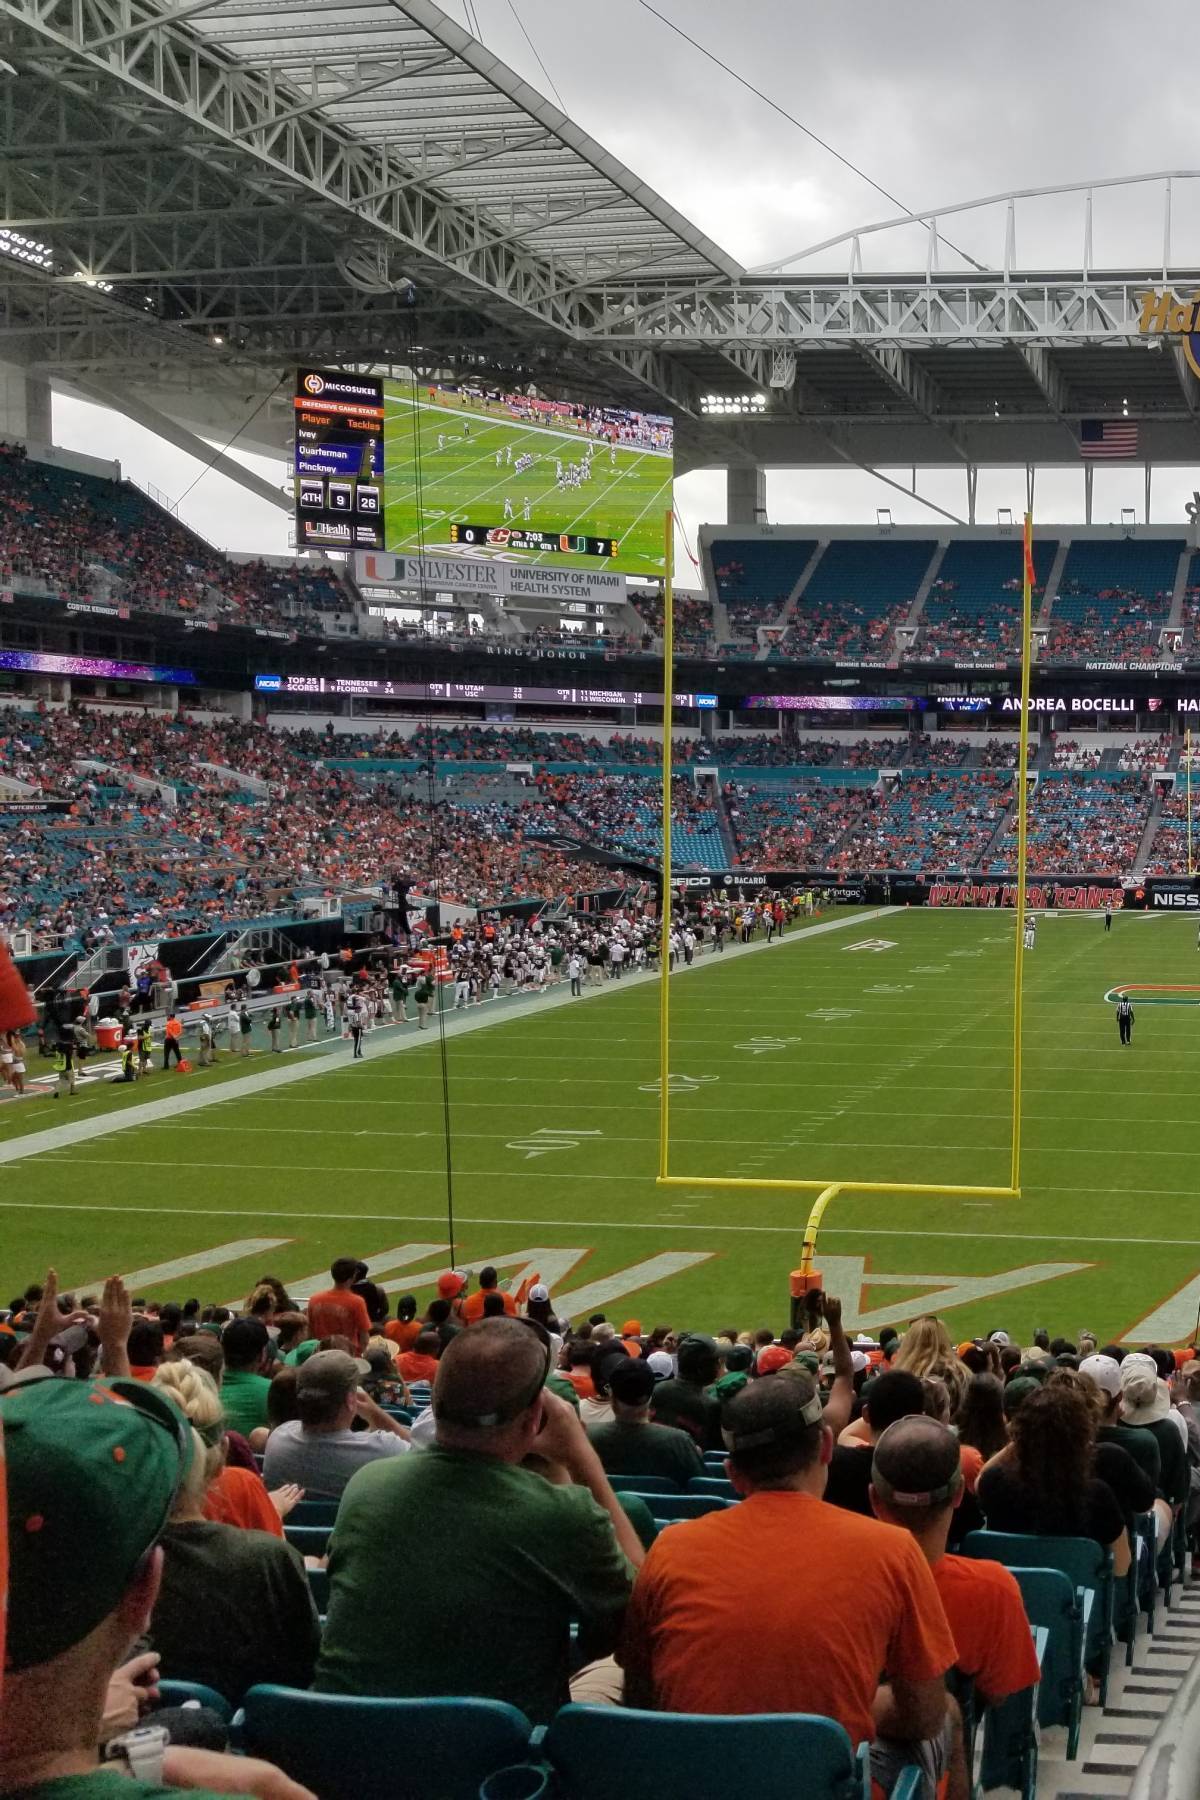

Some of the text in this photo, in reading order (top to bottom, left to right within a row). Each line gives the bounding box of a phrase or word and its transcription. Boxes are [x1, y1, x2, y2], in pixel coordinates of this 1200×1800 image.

[325, 383, 376, 395] MICCOSUKEE
[302, 414, 380, 430] Player Tackles
[299, 429, 316, 439] Ivey
[299, 446, 347, 458] Quarterman
[299, 462, 336, 473] Pinckney
[302, 493, 321, 502] 4TH
[337, 496, 344, 505] 9
[361, 498, 376, 508] 26
[466, 530, 474, 541] 0
[525, 532, 543, 542] 7:03
[597, 543, 604, 554] 7
[408, 559, 496, 583] SYLVESTER
[510, 568, 620, 587] UNIVERSITY OF MIAMI
[510, 582, 591, 597] HEALTH SYSTEM
[67, 603, 91, 613] CORTEZ
[487, 646, 587, 660] RING HONOR
[1086, 662, 1182, 671] NATIONAL CHAMPIONS
[1002, 698, 1066, 710] ANDREA
[1072, 698, 1134, 711] BOCELLI
[734, 876, 766, 885] BACARDÍ
[928, 886, 997, 906] MIAMI
[505, 1128, 602, 1150] 10
